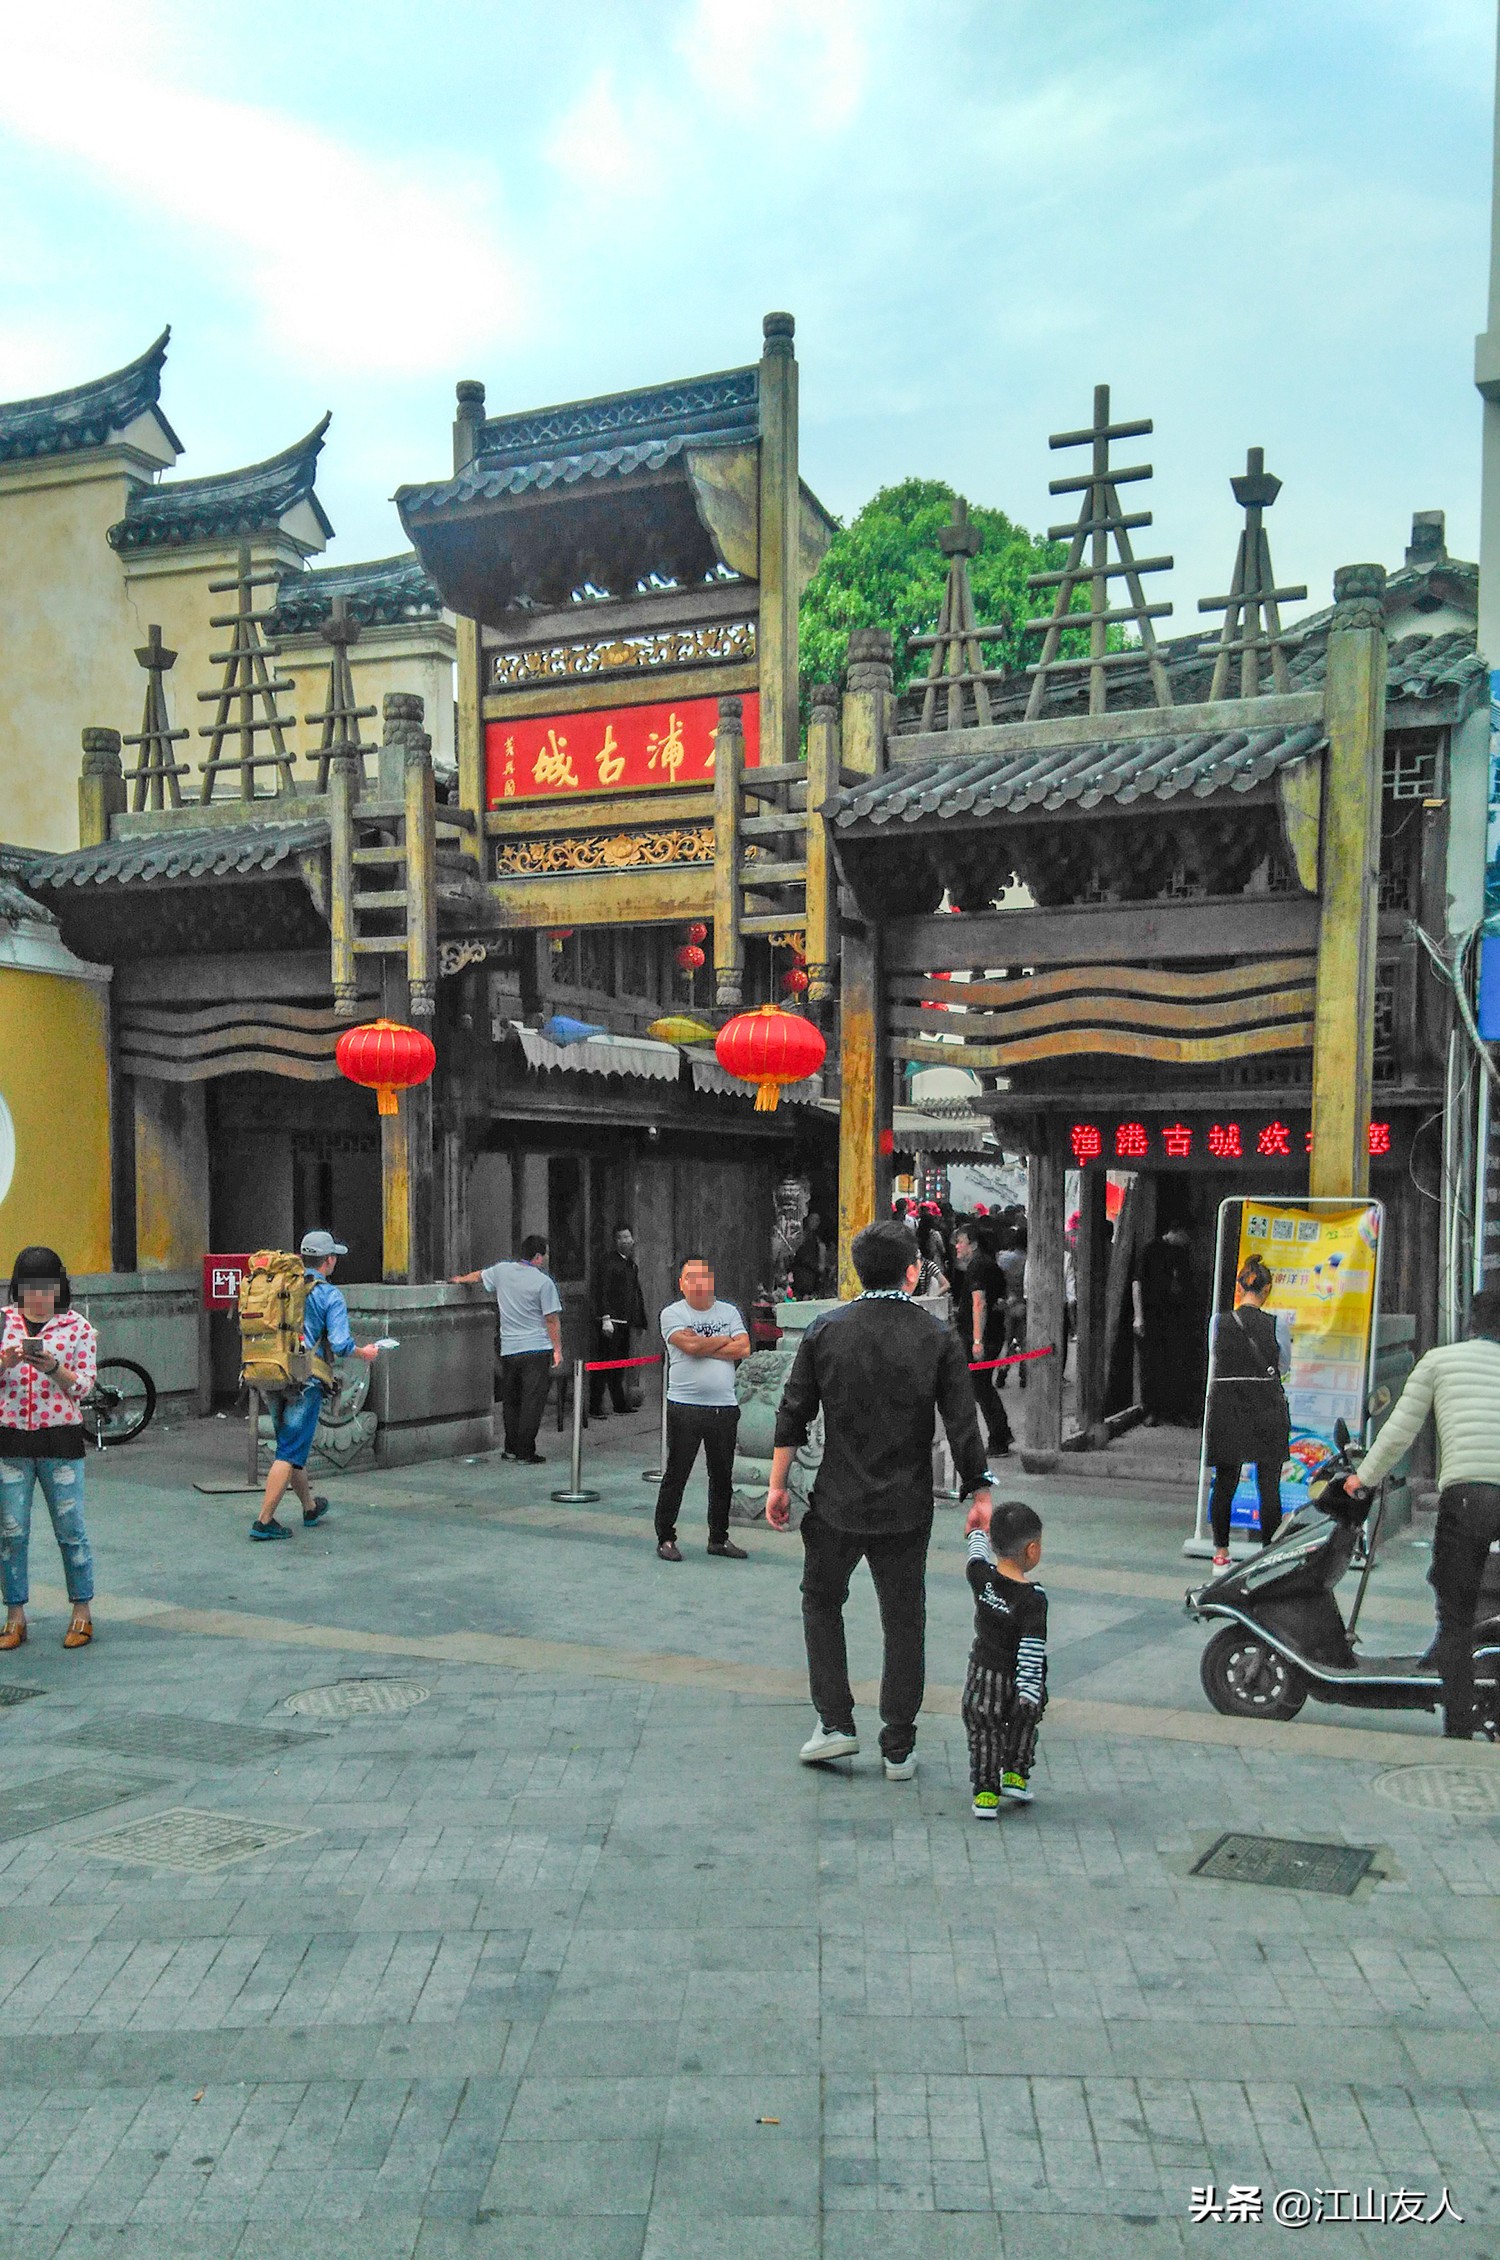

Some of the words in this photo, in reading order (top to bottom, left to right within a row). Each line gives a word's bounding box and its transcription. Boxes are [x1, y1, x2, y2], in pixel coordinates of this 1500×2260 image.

[1070, 1120, 1391, 1157] 渔港古城欢您
